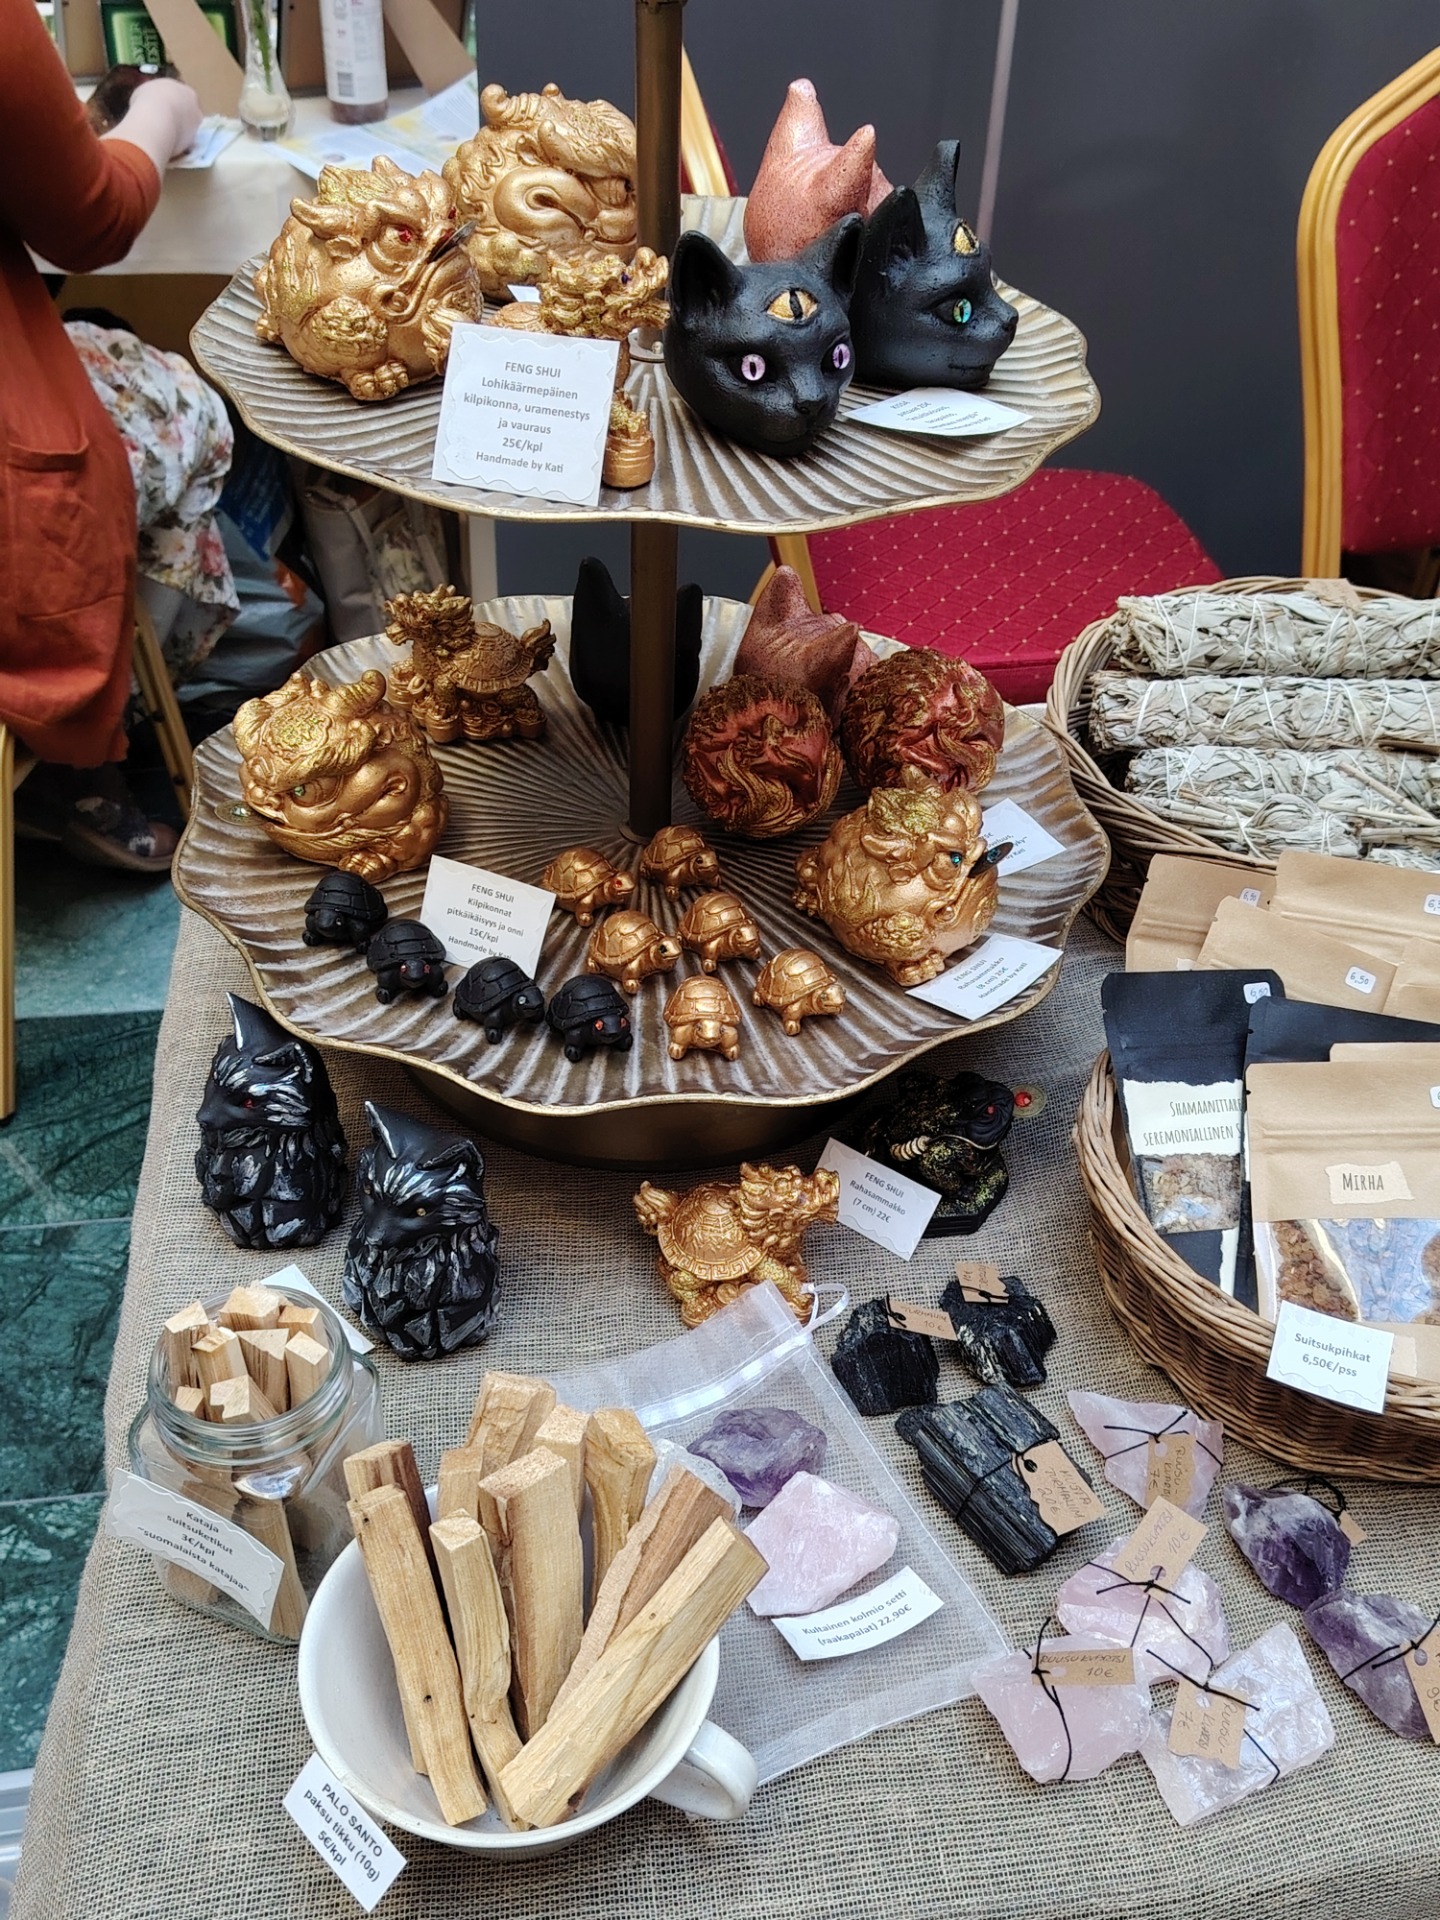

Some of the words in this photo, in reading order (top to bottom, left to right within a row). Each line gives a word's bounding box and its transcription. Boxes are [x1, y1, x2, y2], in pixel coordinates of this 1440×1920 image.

[505, 362, 532, 375] FENG
[535, 366, 561, 378] SHUI
[482, 377, 578, 400] Lohikäärmepäinen
[464, 392, 521, 413] kilpikonna,
[524, 404, 590, 422] uramenestys
[497, 417, 508, 429] ja
[511, 422, 551, 435] vauraus
[502, 437, 543, 453] 25€/kpl
[476, 452, 529, 468] Handmade
[531, 459, 543, 472] by
[545, 463, 563, 473] Kati
[472, 883, 494, 897] FENG
[495, 891, 514, 903] SHUI
[468, 898, 512, 918] Kilpikonnat
[447, 907, 497, 928] pitkäikäisyys
[498, 923, 506, 931] ja
[507, 926, 524, 937] onni
[448, 935, 487, 954] Handmade
[469, 927, 499, 943] 15€/kpl
[954, 968, 970, 982] FENG
[971, 959, 988, 972] SHUI
[958, 957, 1004, 990] Rahasammakko
[985, 974, 996, 986] cm)
[1350, 972, 1369, 985] 6,50
[978, 978, 1010, 999] Handmade
[1009, 971, 1018, 981] by
[1143, 1125, 1234, 1146] SEREMONIALLINEN
[865, 1172, 885, 1188] FENG
[885, 1183, 905, 1198] SHUI
[849, 1180, 906, 1215] Rahasammakko
[852, 1197, 862, 1206] (7
[862, 1203, 877, 1216] cm)
[876, 1210, 892, 1223] 22€
[1294, 1333, 1371, 1363] Suitsukpihkat
[1302, 1353, 1358, 1377] 6,50€/pss
[186, 1511, 219, 1534] Kataja
[166, 1515, 234, 1556] suitsuketikut
[181, 1533, 215, 1557] 3€/kpl
[137, 1526, 207, 1565] ~suomalaista
[209, 1561, 250, 1592] katajaa~
[801, 1619, 850, 1635] Kultainen
[850, 1605, 885, 1623] kolmio
[885, 1589, 907, 1607] setti
[817, 1622, 879, 1646] (raakapalat)
[878, 1603, 912, 1627] 22,90€
[321, 1783, 349, 1817] PALO
[348, 1815, 383, 1857] SANTO
[303, 1789, 333, 1824] paksu
[332, 1822, 356, 1852] tikku
[354, 1850, 380, 1882] (10g)
[318, 1830, 347, 1866] 5€/kpl
